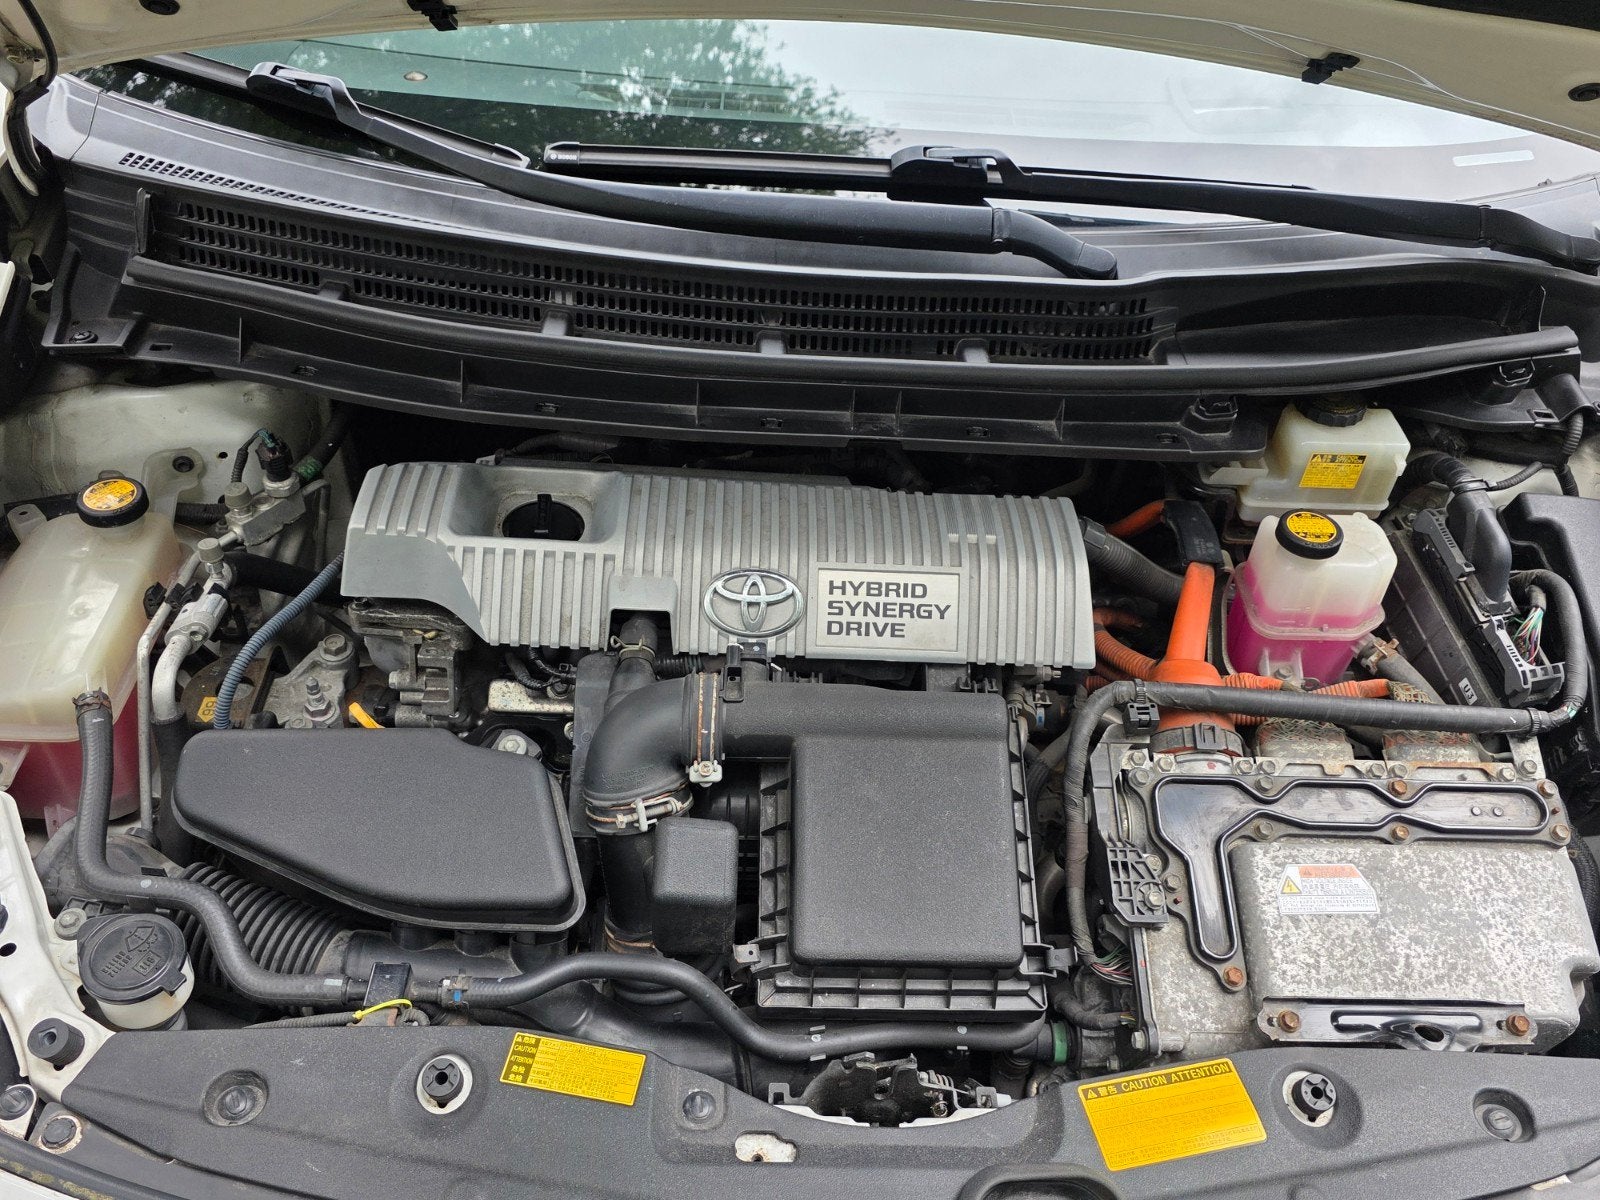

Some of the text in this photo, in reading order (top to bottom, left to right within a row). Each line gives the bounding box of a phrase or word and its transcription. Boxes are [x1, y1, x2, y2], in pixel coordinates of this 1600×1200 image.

[828, 580, 928, 598] HYBRID
[827, 600, 951, 620] SYNERGY
[826, 620, 906, 638] DRIVE
[513, 1044, 538, 1054] CAUTION
[510, 1055, 534, 1065] ATTENTION
[1098, 1063, 1230, 1097] 警告 CAUTION ATTENTION
